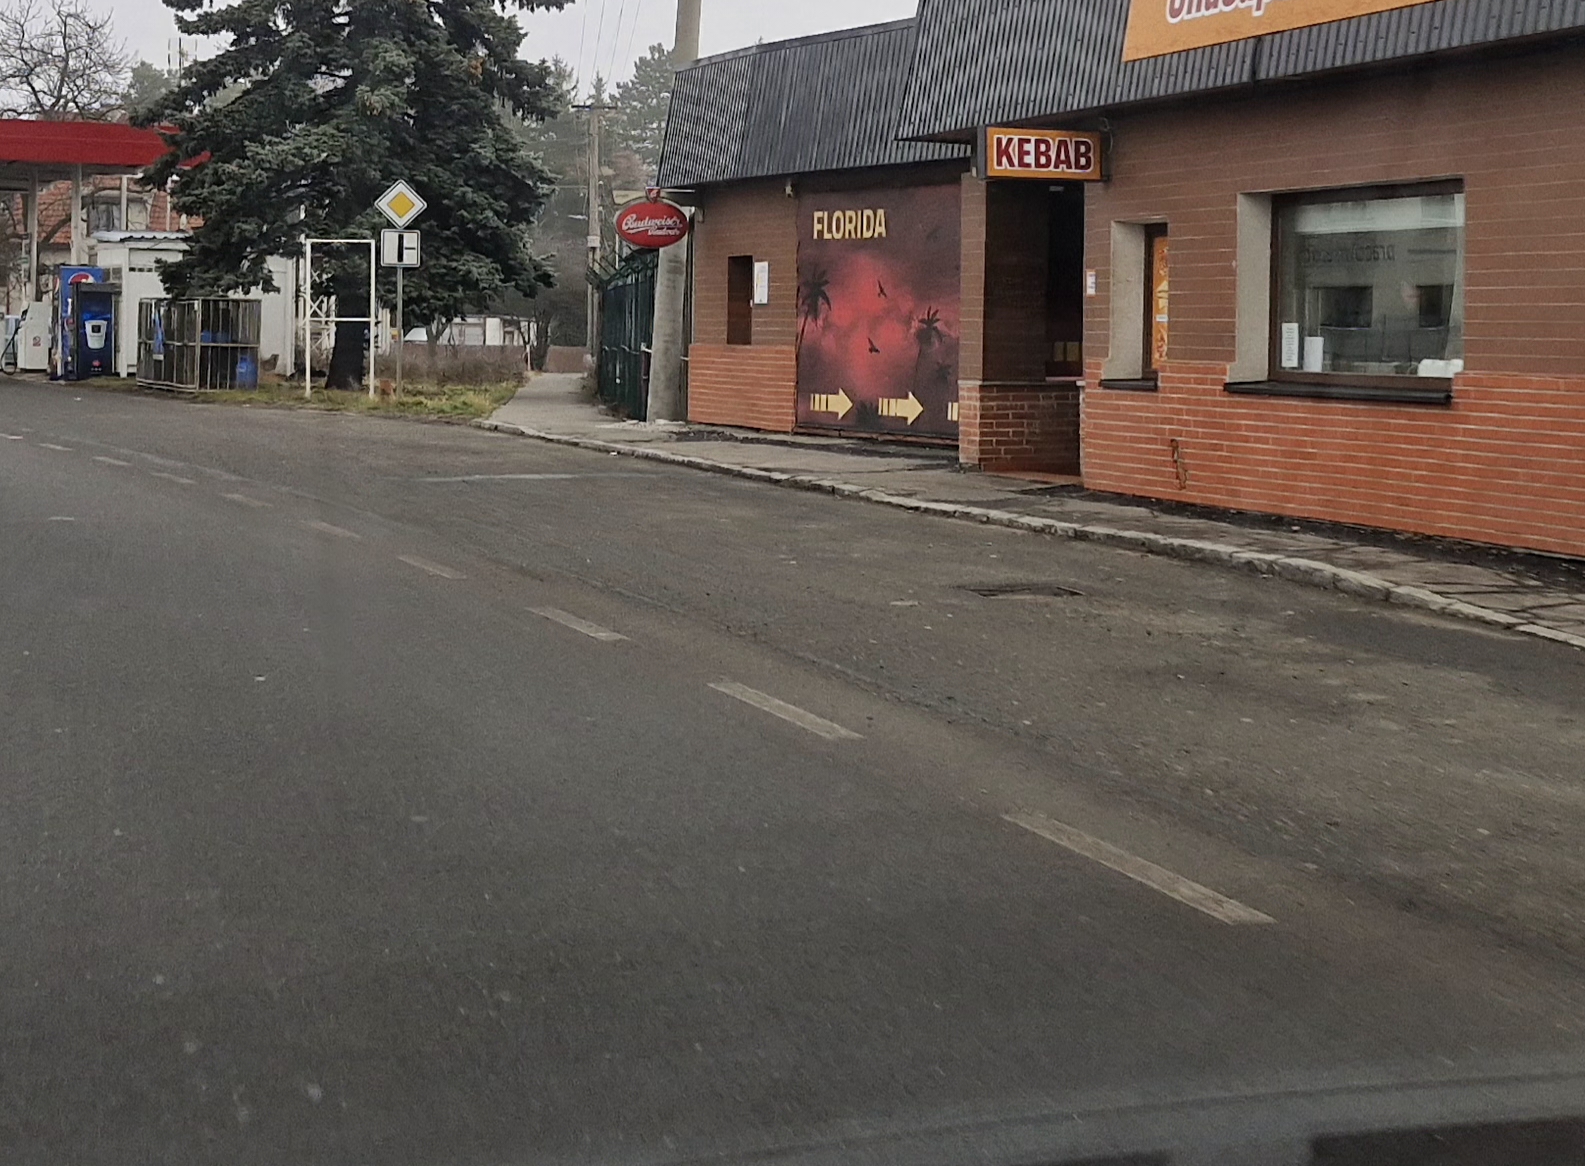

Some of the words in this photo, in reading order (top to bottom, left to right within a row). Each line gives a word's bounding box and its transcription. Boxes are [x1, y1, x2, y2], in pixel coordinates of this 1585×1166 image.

[995, 135, 1094, 173] KEBAB
[622, 213, 682, 233] Budweiser
[813, 208, 887, 240] FLORIDA
